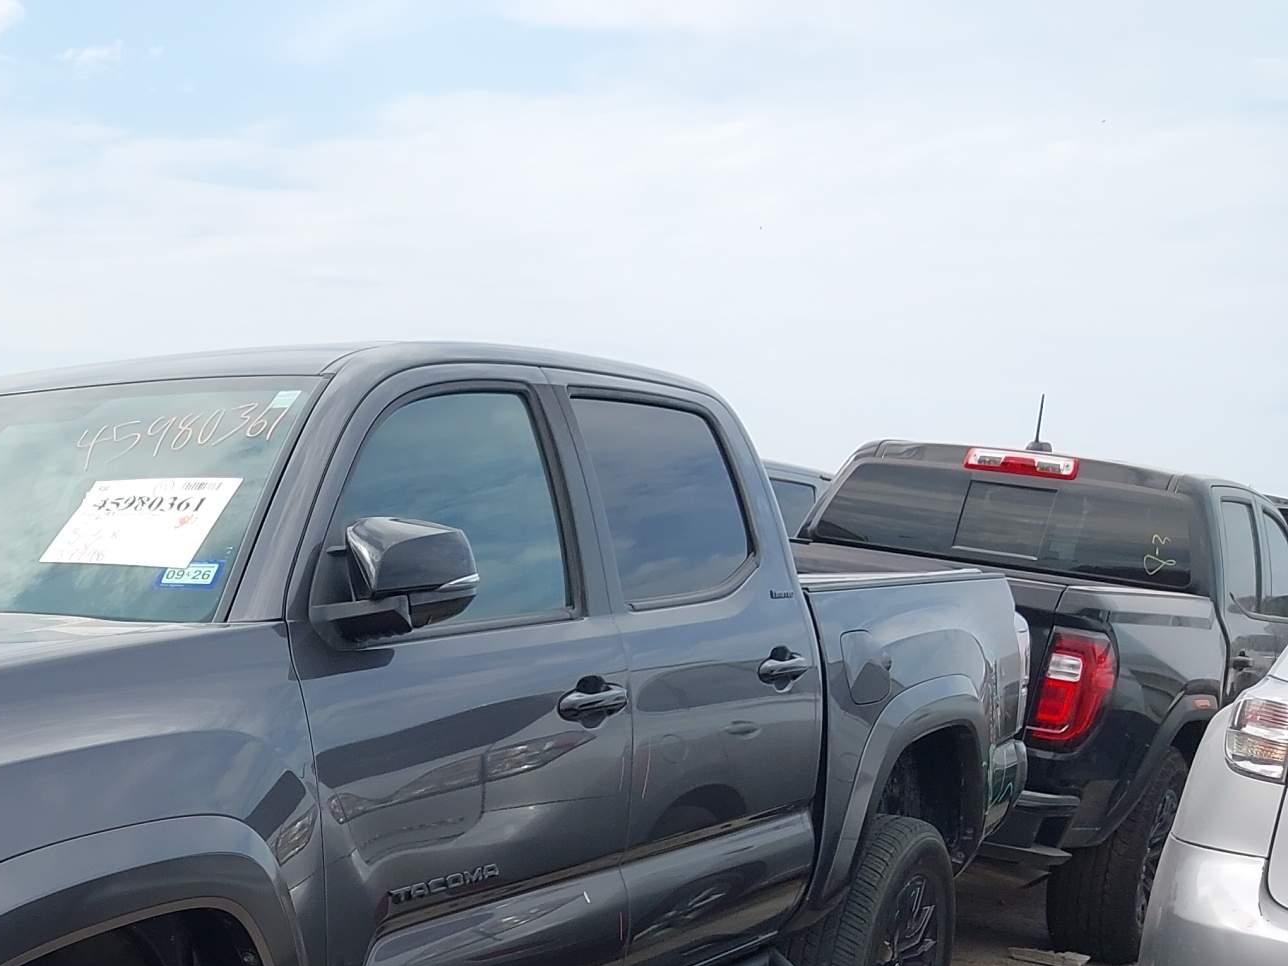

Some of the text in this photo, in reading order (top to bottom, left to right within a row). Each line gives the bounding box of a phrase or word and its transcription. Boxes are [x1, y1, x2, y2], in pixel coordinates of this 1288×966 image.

[76, 401, 290, 472] 45980361
[93, 496, 207, 512] 45980361
[165, 569, 212, 580] 09 26
[389, 863, 500, 903] TACOMA
